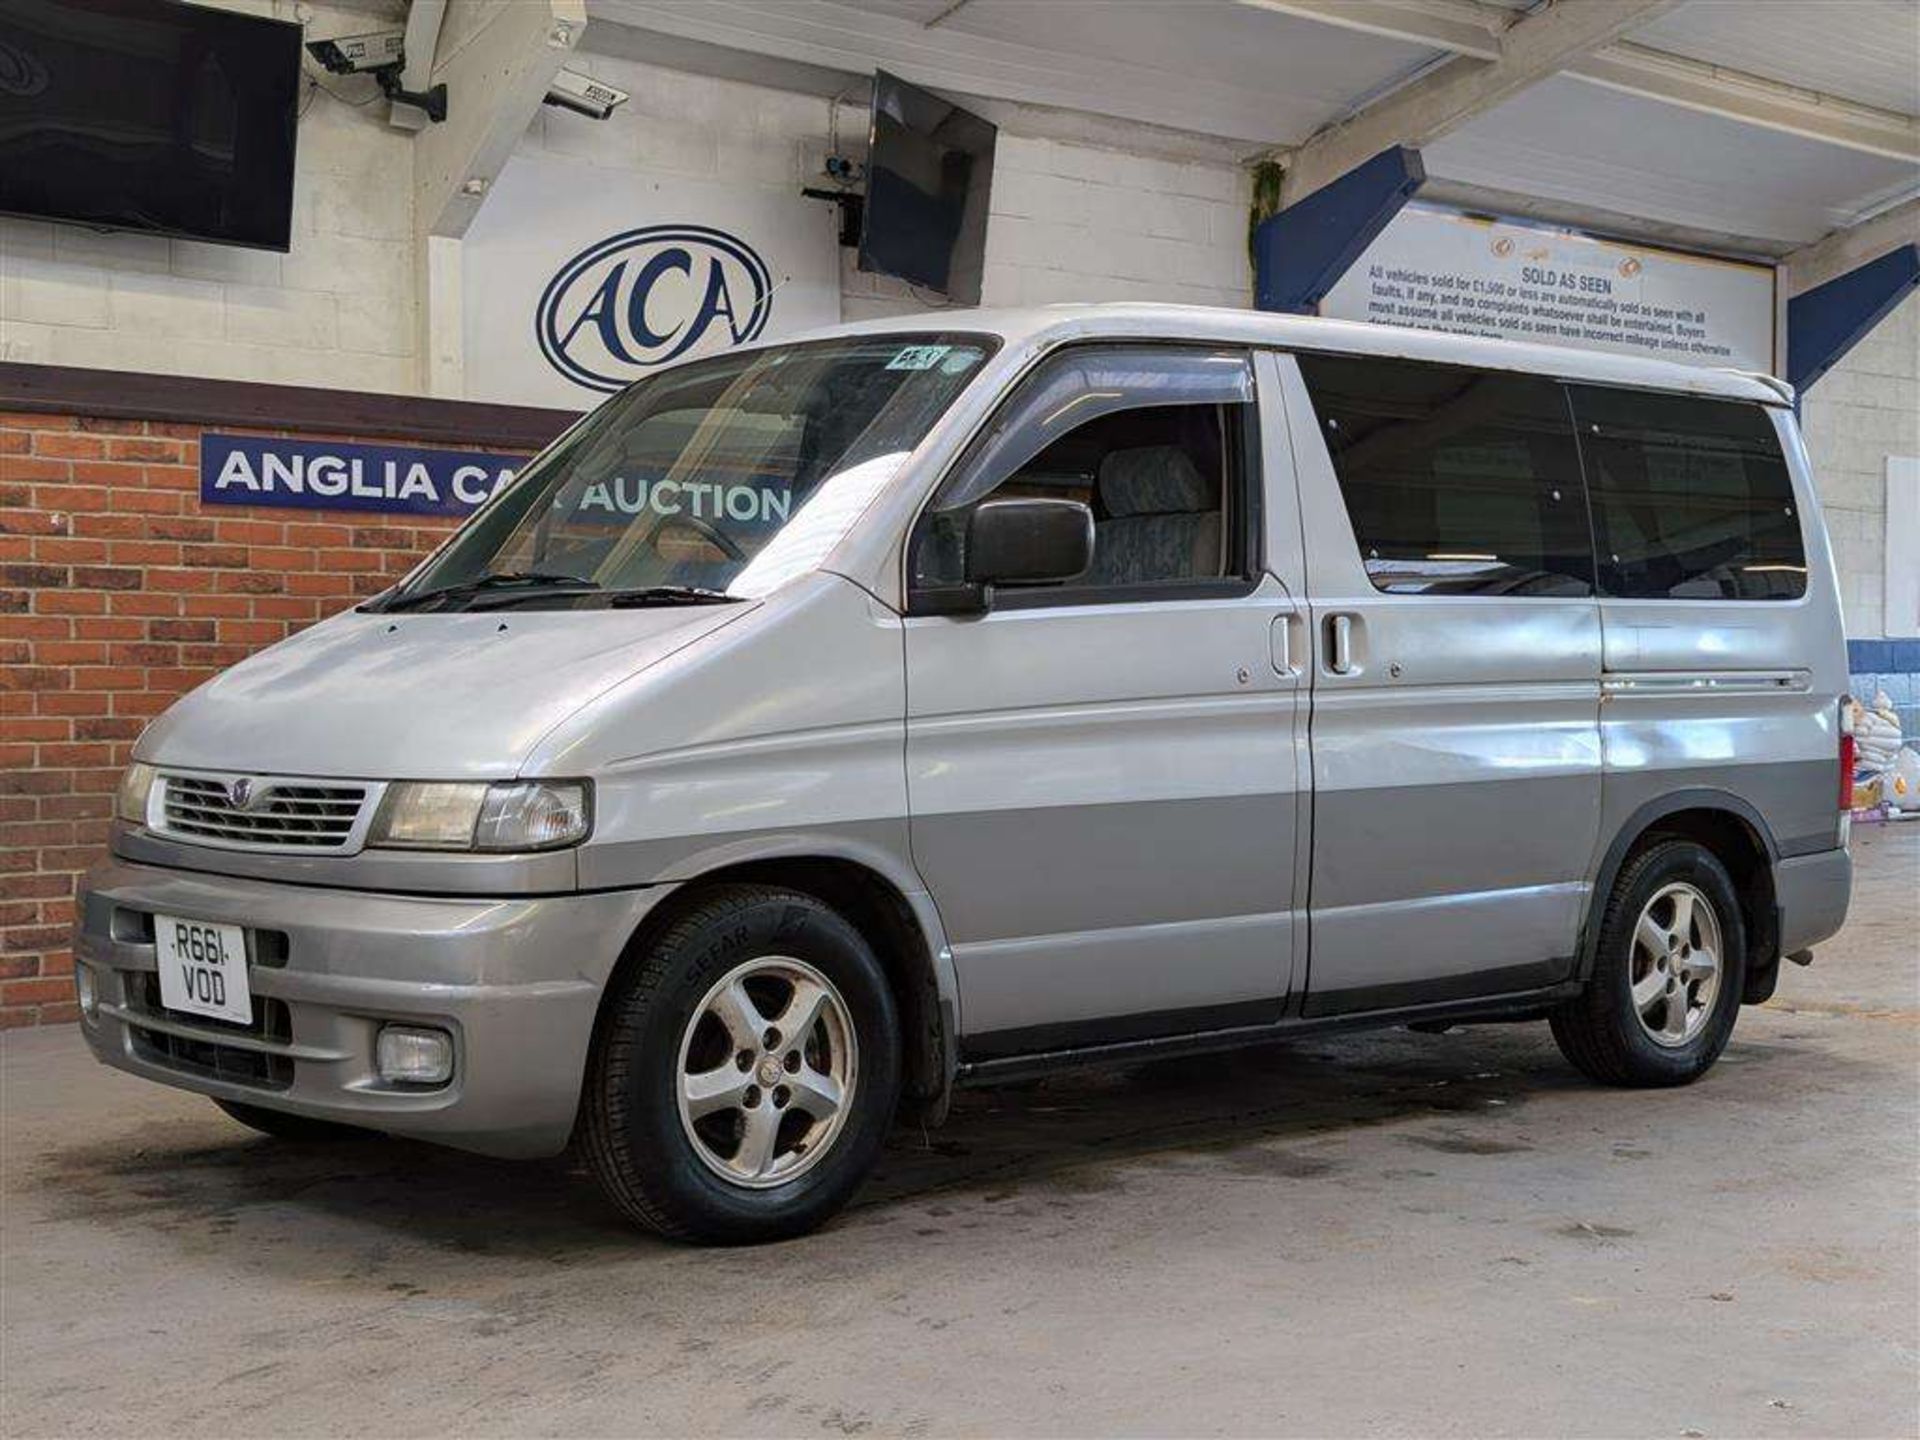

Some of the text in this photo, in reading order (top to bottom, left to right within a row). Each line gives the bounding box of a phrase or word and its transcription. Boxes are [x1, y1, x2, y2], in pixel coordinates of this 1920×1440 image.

[1369, 265, 1383, 278] All
[1386, 269, 1429, 285] vehicles
[1431, 275, 1453, 288] sold
[1457, 277, 1470, 290] for
[1507, 286, 1517, 296] or
[1519, 286, 1538, 300] less
[1541, 291, 1556, 302] are
[1558, 294, 1616, 313] automatically
[1620, 302, 1639, 314] sold
[1641, 306, 1651, 316] as
[1654, 308, 1673, 319] seen
[1676, 310, 1692, 322] with
[1695, 312, 1705, 323] all
[1522, 267, 1611, 294] SOLD AS SEEN
[556, 248, 741, 366] ACA
[1398, 305, 1437, 319] assume
[1441, 308, 1453, 321] all
[1455, 312, 1496, 327] vehicles
[1499, 316, 1519, 329] sold
[1522, 321, 1532, 331] as
[1536, 323, 1556, 334] seen
[1560, 324, 1580, 337] have
[1583, 327, 1623, 342] incorrect
[1626, 333, 1659, 349] mileage
[1662, 338, 1688, 351] unless
[1691, 342, 1730, 357] otherwise
[1407, 287, 1414, 299] if
[1440, 293, 1459, 306] and
[1462, 297, 1474, 308] no
[1477, 299, 1529, 315] complaints
[1532, 303, 1584, 322] whatsoever
[1587, 312, 1608, 326] shall
[1611, 315, 1622, 327] be
[1677, 324, 1705, 338] Buyers
[215, 450, 439, 502] ANGLIA
[579, 478, 792, 523] AUCTION
[176, 923, 225, 966] R661
[182, 964, 226, 1006] VOD
